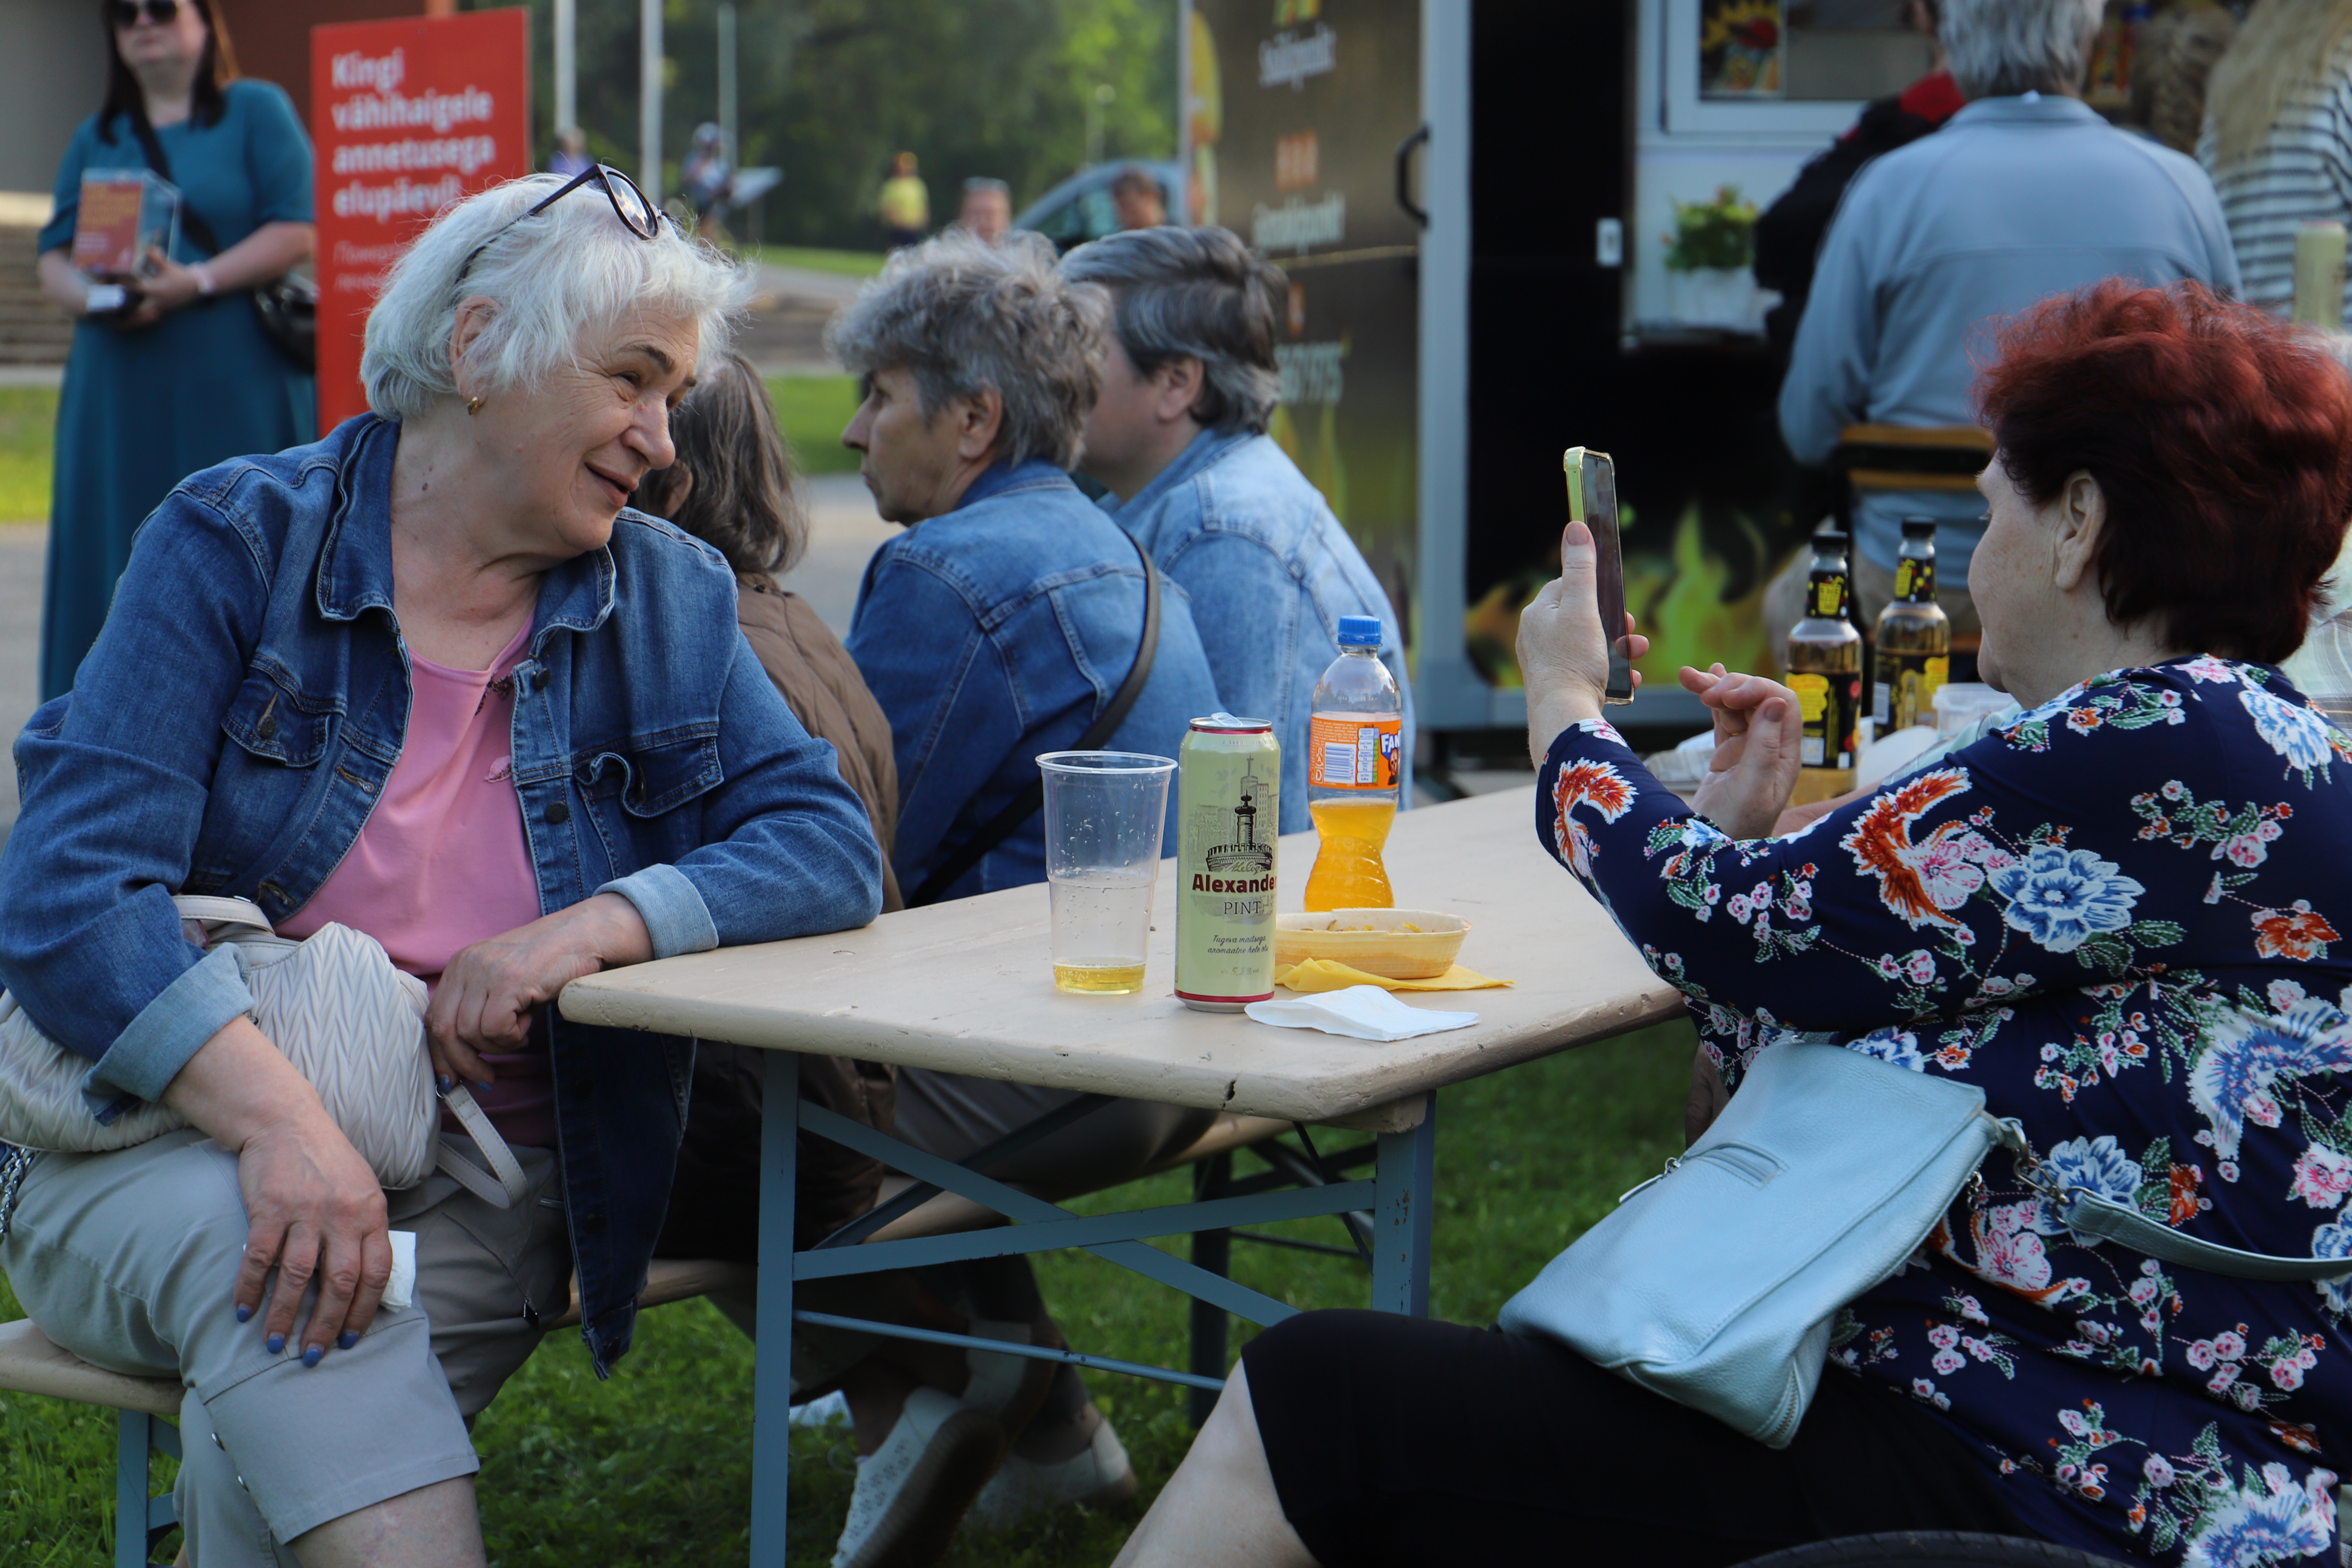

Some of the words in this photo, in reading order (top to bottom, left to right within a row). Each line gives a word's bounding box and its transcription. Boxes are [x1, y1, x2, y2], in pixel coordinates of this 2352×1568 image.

[332, 47, 404, 92] Kingi
[331, 85, 493, 133] vähihaigele
[332, 135, 496, 175] annetusega
[1223, 901, 1261, 915] PINT
[1213, 935, 1237, 946] Tugeva
[1239, 935, 1266, 945] maitsega
